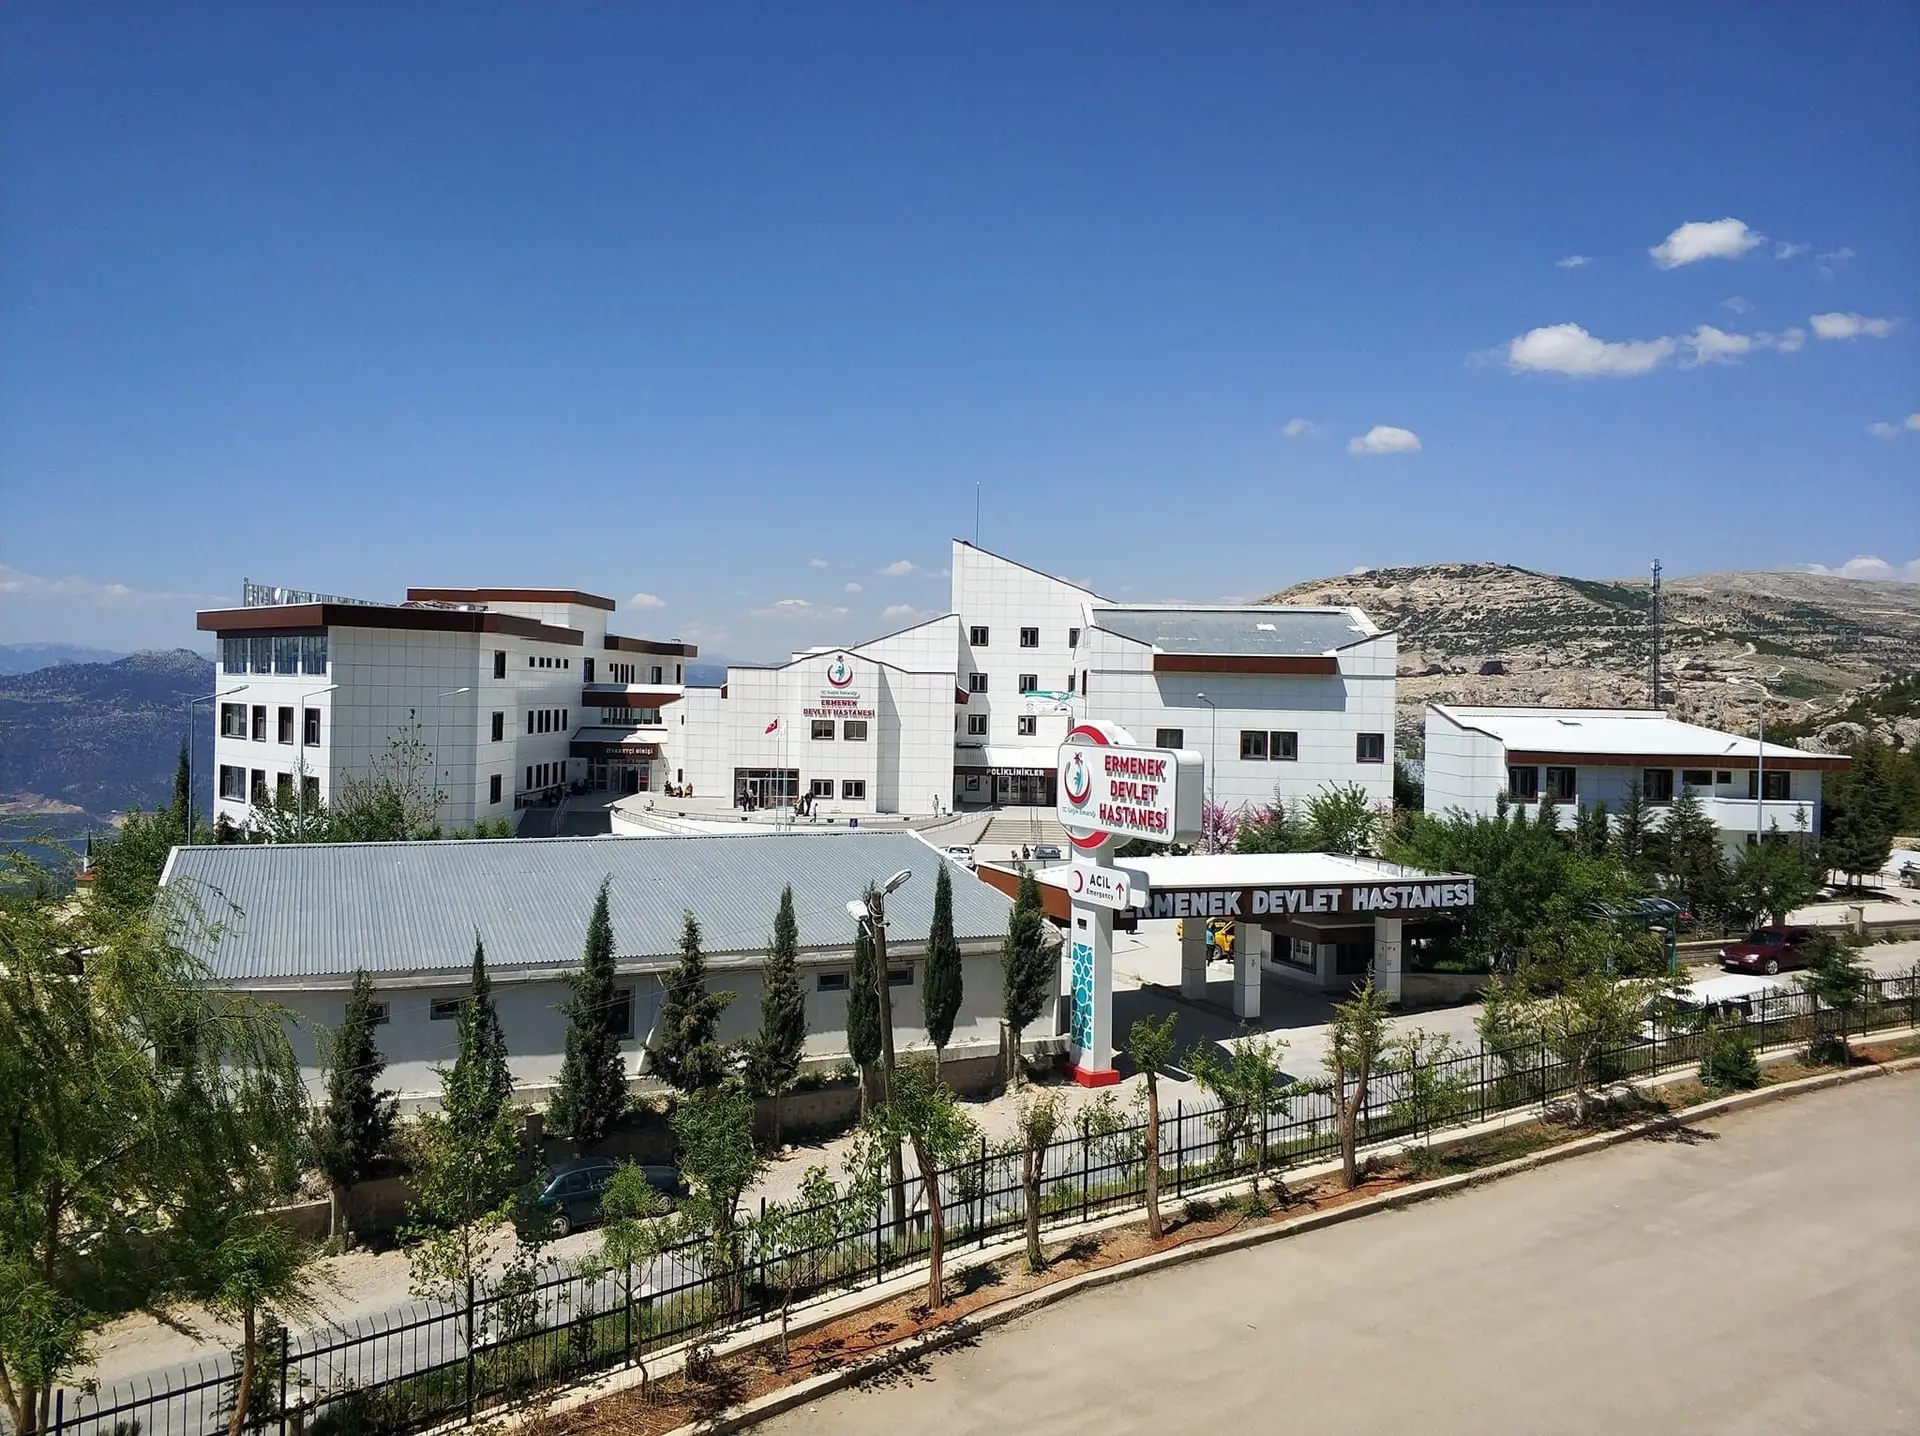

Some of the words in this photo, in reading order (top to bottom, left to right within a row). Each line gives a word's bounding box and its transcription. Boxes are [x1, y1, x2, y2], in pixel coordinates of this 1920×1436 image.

[986, 767, 1044, 776] POLİKLİNİKLER
[1104, 755, 1166, 776] ERMENEK
[1110, 780, 1157, 802] DEVLET
[1099, 803, 1168, 829] HASTANESİ
[1086, 888, 1114, 901] Emergency
[1252, 888, 1342, 914] DEVLET
[1352, 880, 1475, 911] HASTANESİ
